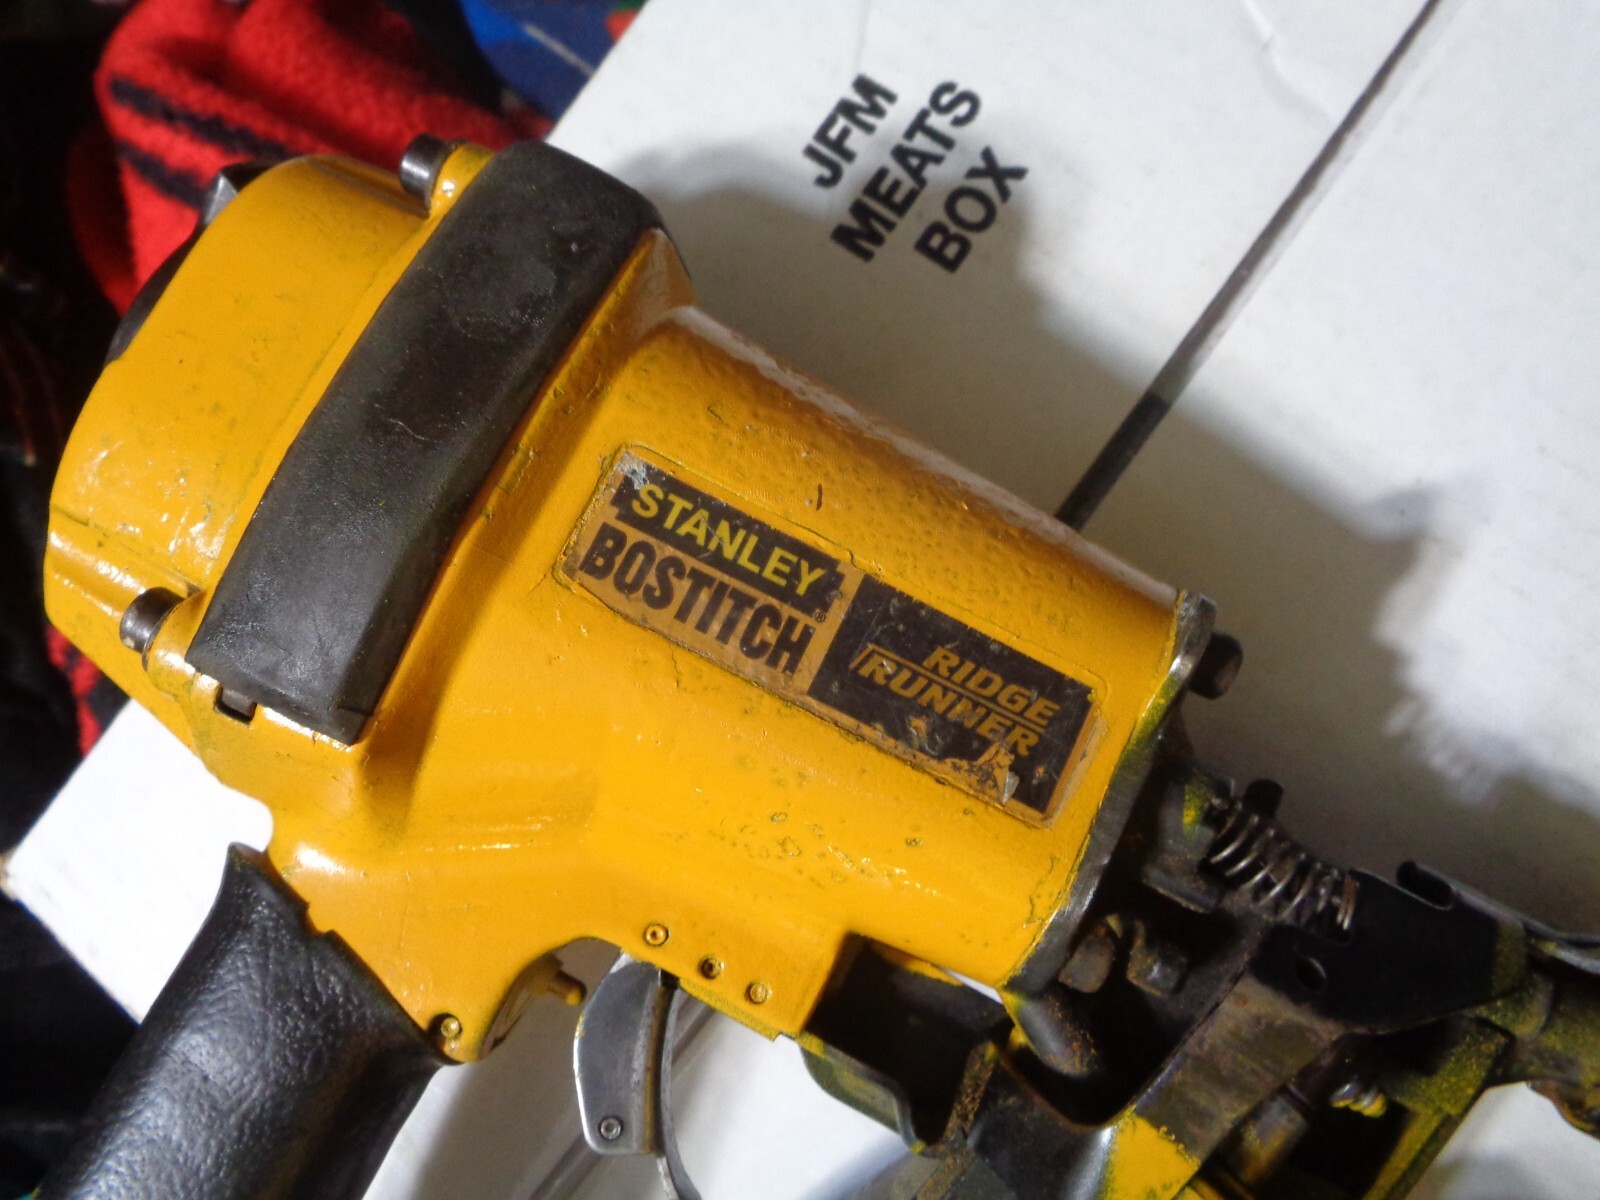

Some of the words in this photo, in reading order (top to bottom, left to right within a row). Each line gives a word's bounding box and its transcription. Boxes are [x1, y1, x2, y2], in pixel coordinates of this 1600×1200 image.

[802, 73, 898, 189] JFM
[830, 81, 982, 262] MEATS
[913, 145, 1029, 274] BOX
[631, 484, 826, 596] STANLEY
[579, 522, 816, 676] BOSTITCH
[858, 651, 1040, 757] RUNNER
[922, 645, 1060, 726] RIDGE
